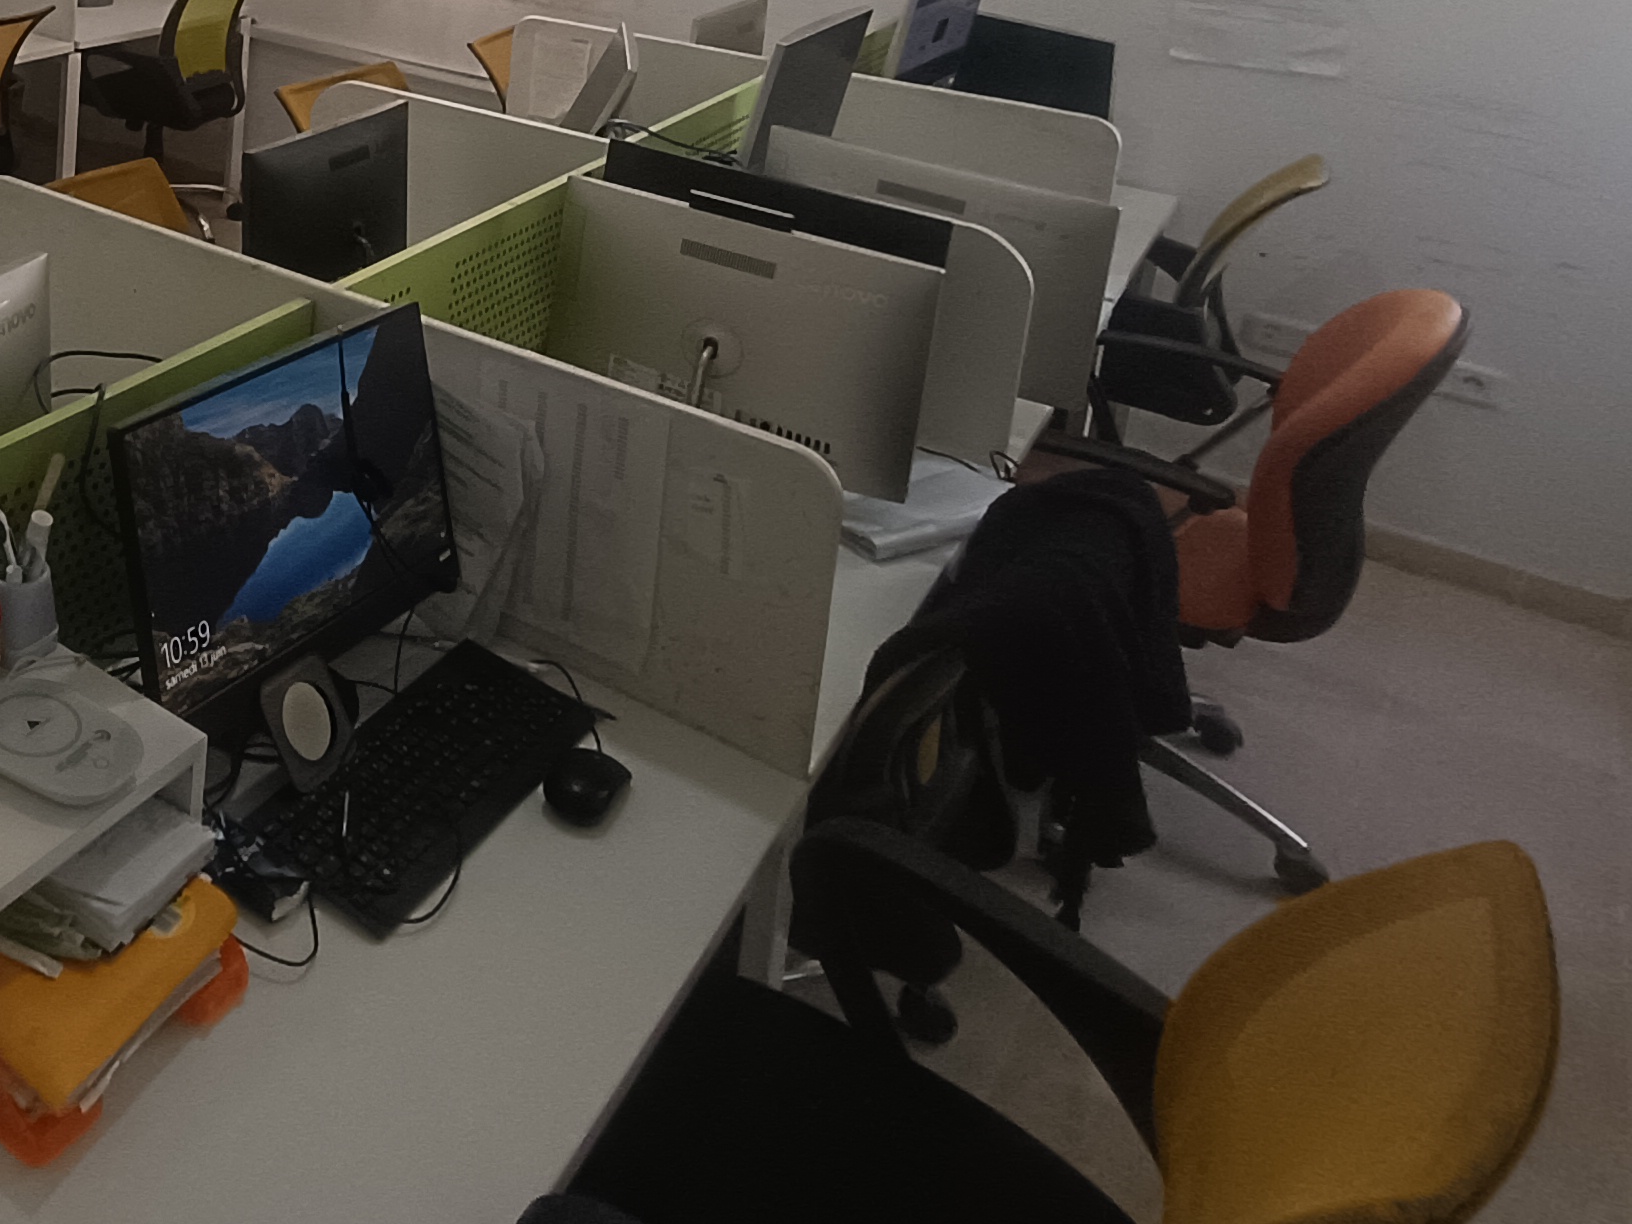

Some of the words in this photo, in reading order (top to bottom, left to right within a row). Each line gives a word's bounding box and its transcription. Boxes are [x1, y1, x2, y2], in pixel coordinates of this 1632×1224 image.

[160, 619, 211, 668] 10:59
[165, 660, 198, 691] samedi
[198, 652, 209, 669] 13
[209, 644, 227, 668] juin
